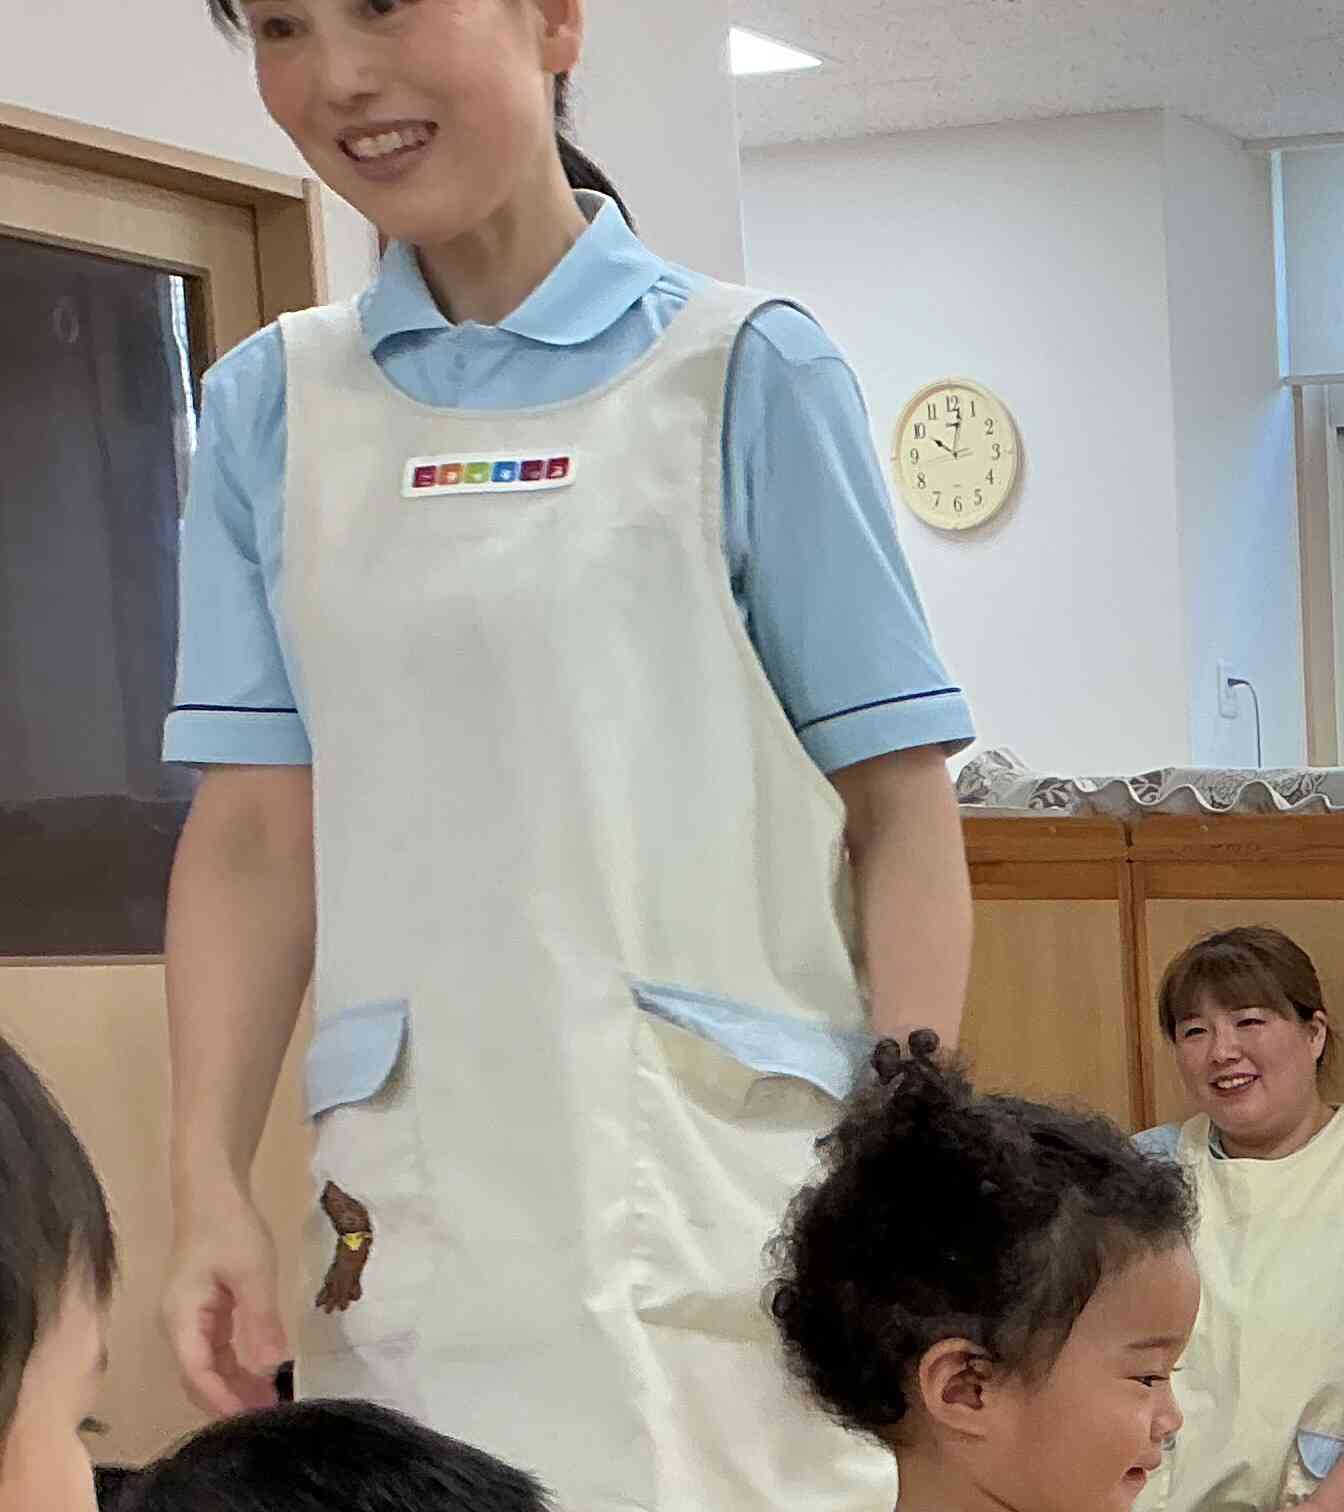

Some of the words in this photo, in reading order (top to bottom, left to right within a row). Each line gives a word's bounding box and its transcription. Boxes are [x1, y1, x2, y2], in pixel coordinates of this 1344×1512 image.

[927, 403, 937, 420] 11
[913, 422, 926, 439] 10
[984, 418, 994, 435] 2
[910, 448, 919, 465] 9
[991, 443, 1000, 461] 3
[917, 472, 926, 490] 8
[985, 468, 994, 485] 4
[932, 490, 941, 507] 7
[953, 496, 962, 512] 6
[974, 488, 982, 505] 5
